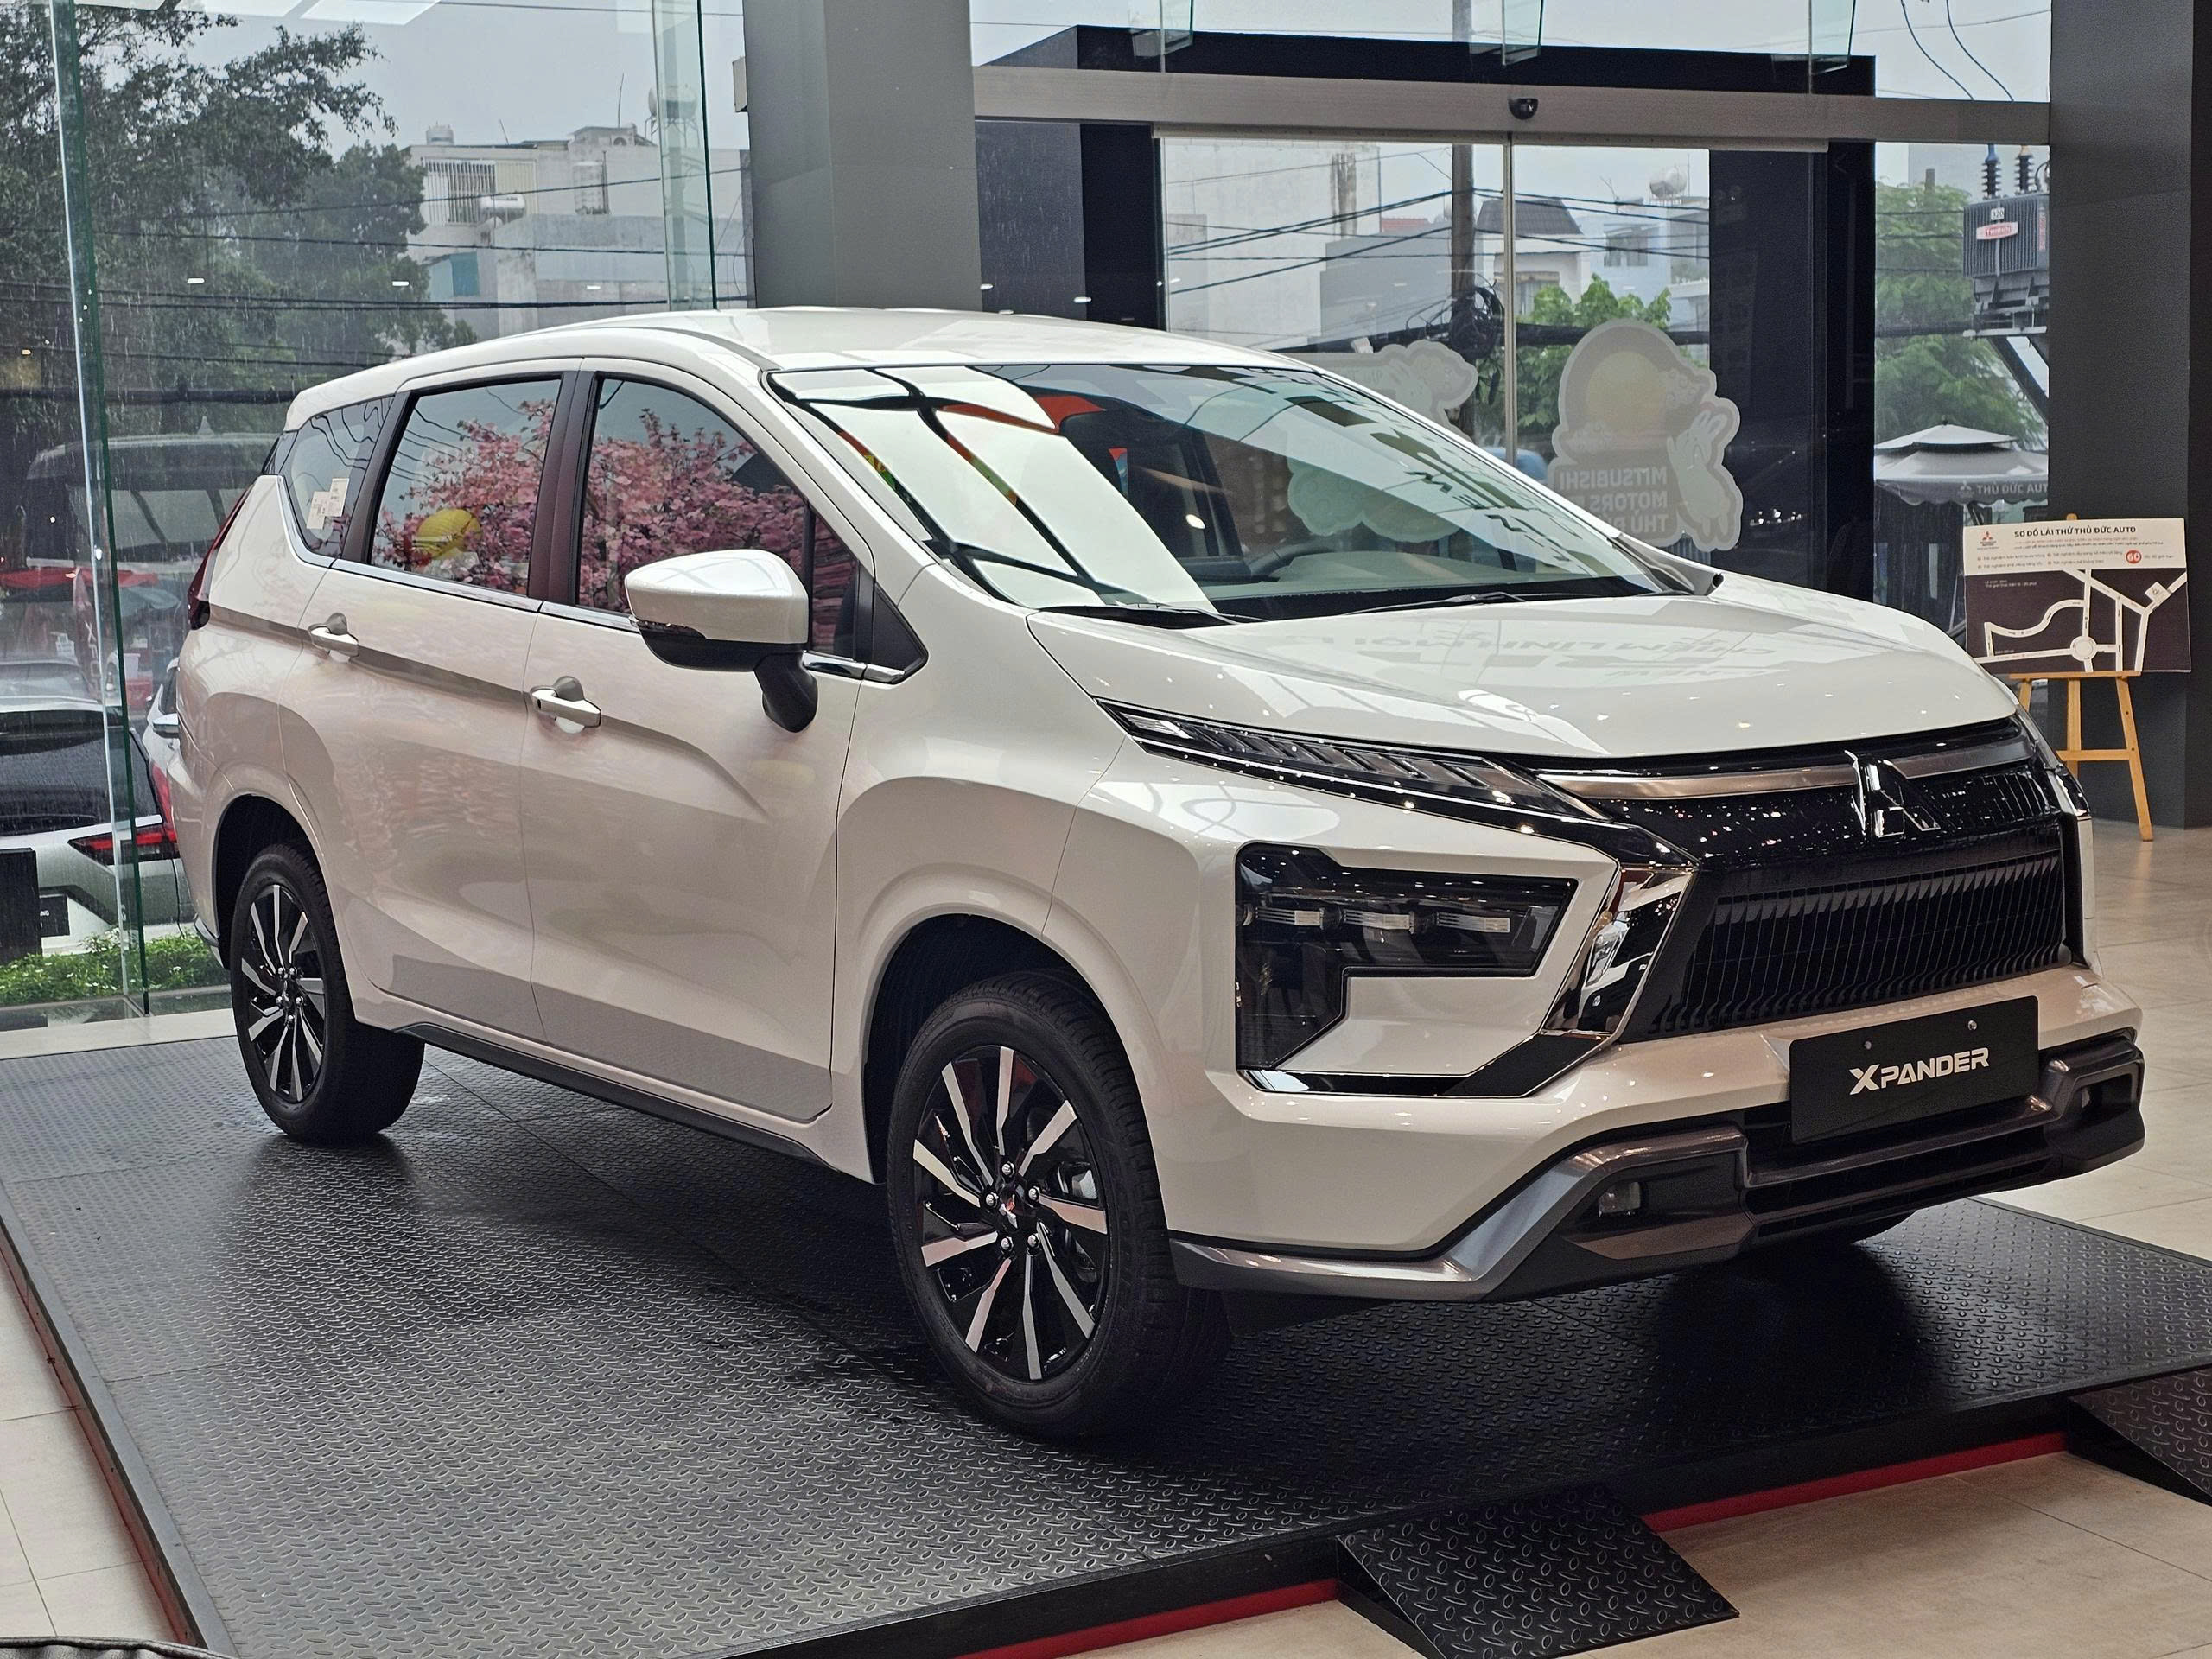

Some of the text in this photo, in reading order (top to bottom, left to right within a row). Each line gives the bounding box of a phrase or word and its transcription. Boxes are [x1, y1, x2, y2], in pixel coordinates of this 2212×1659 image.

[1976, 480, 1998, 494] THỦ
[2002, 481, 2024, 493] ĐỨC
[2027, 483, 2048, 493] AUT
[2014, 530, 2026, 538] SƠ
[2094, 525, 2112, 534] ĐỨC
[1849, 1047, 1990, 1096] XPANDER
